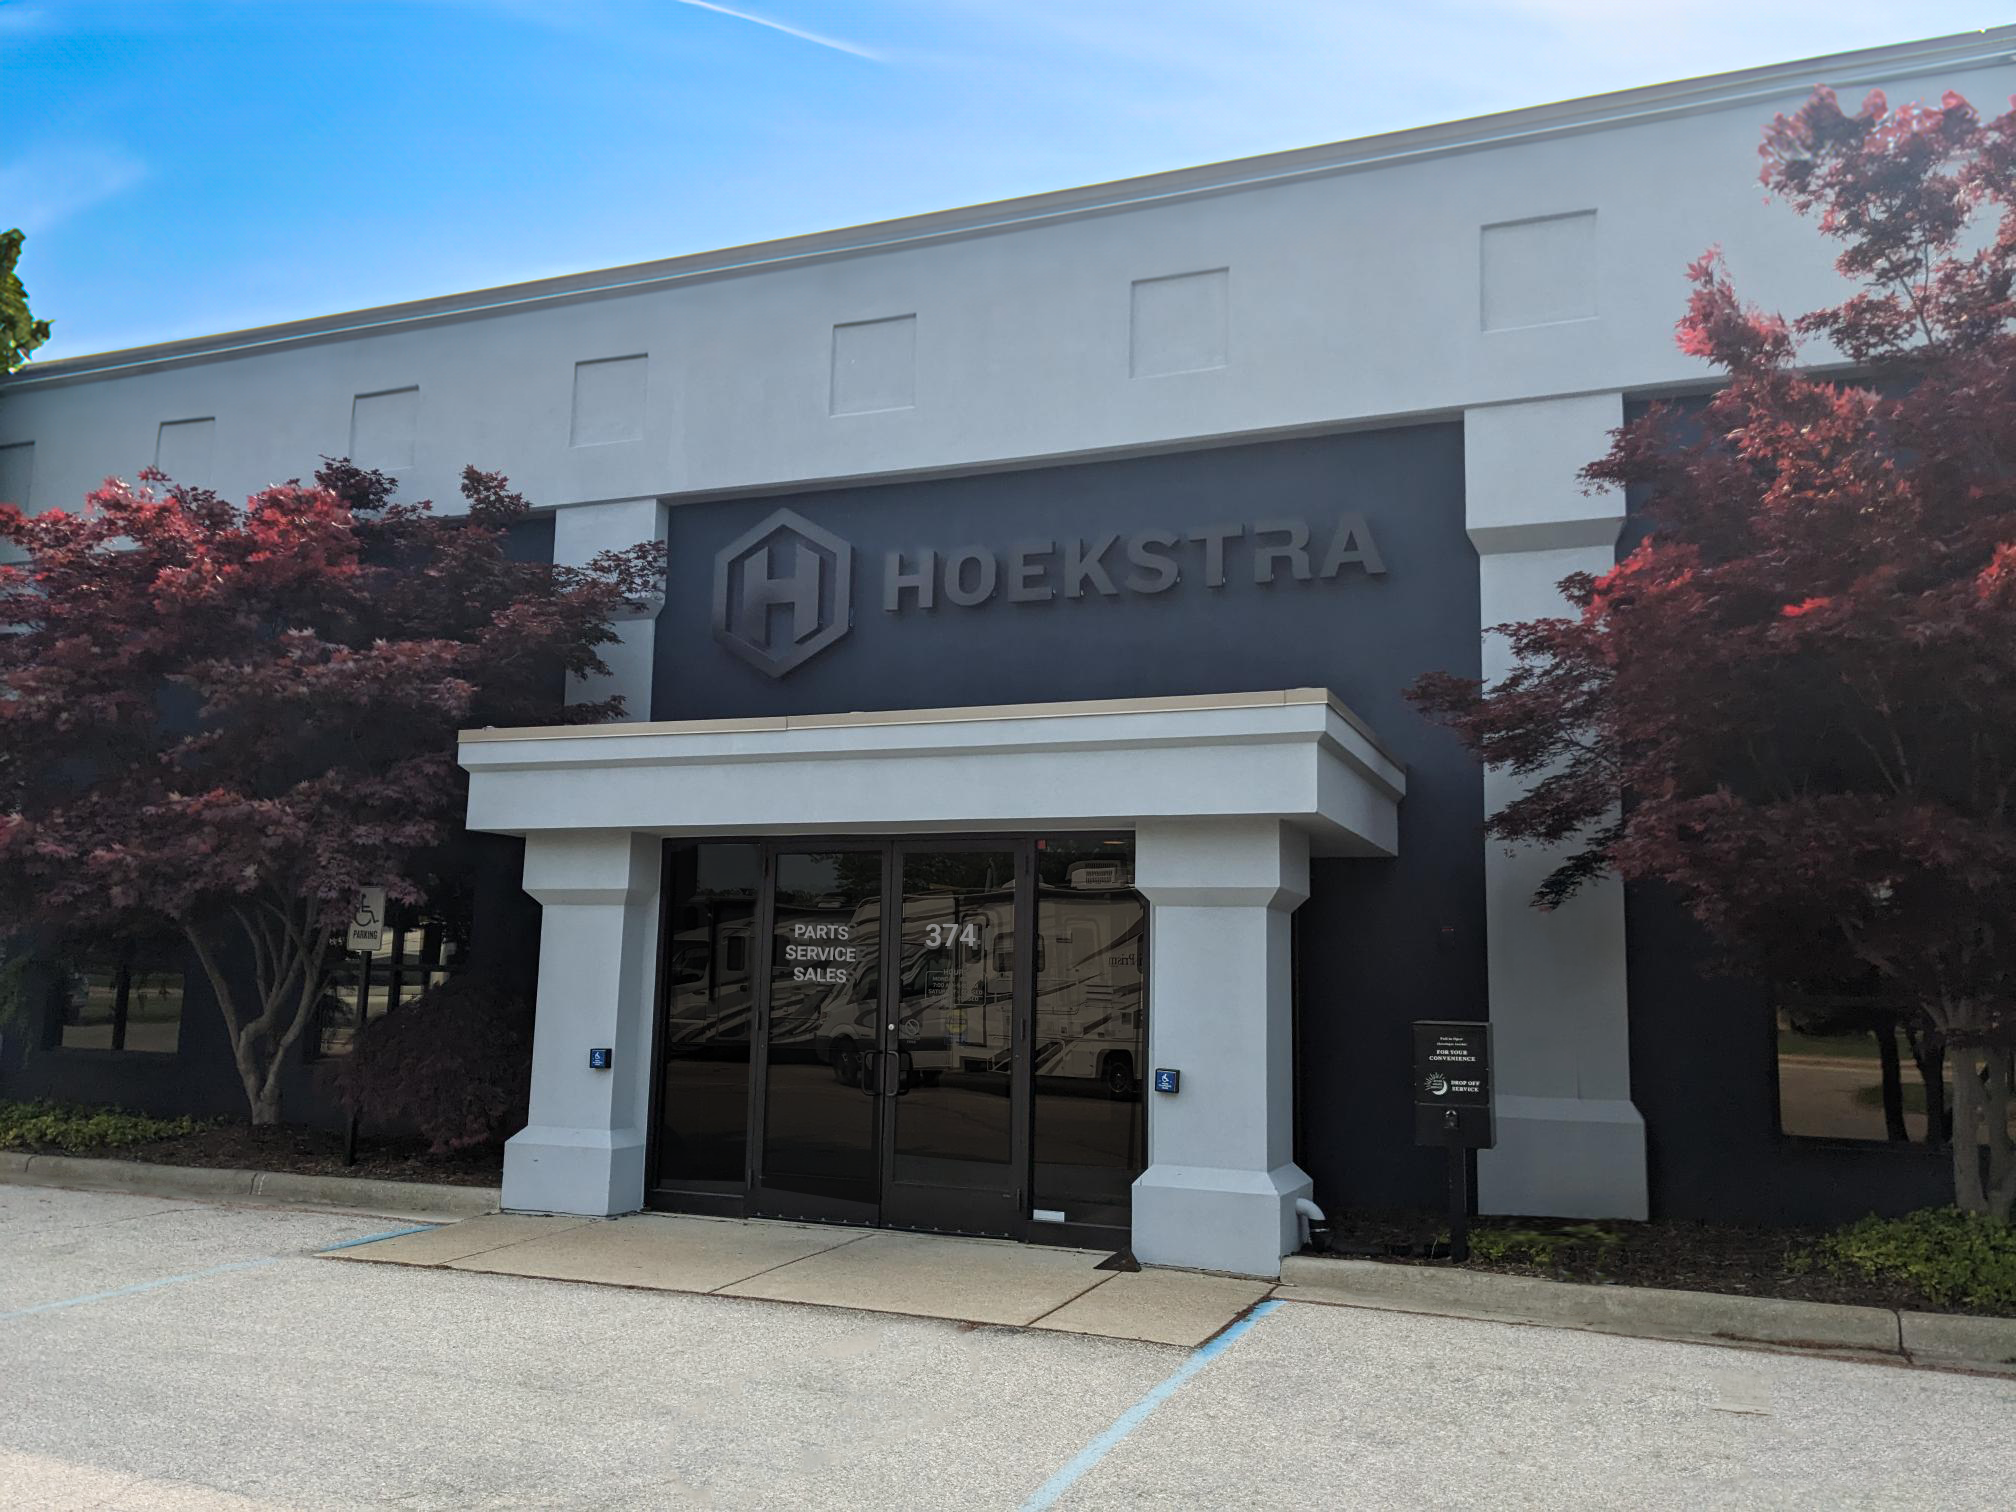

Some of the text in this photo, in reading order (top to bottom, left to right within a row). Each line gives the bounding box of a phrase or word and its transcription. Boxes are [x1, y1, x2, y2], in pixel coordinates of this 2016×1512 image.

[882, 512, 1387, 613] HOEKSTRA
[353, 930, 378, 939] PARKING
[794, 924, 849, 940] PARTS
[925, 923, 976, 947] 374
[785, 945, 856, 962] SERVICE
[793, 967, 847, 983] SALES
